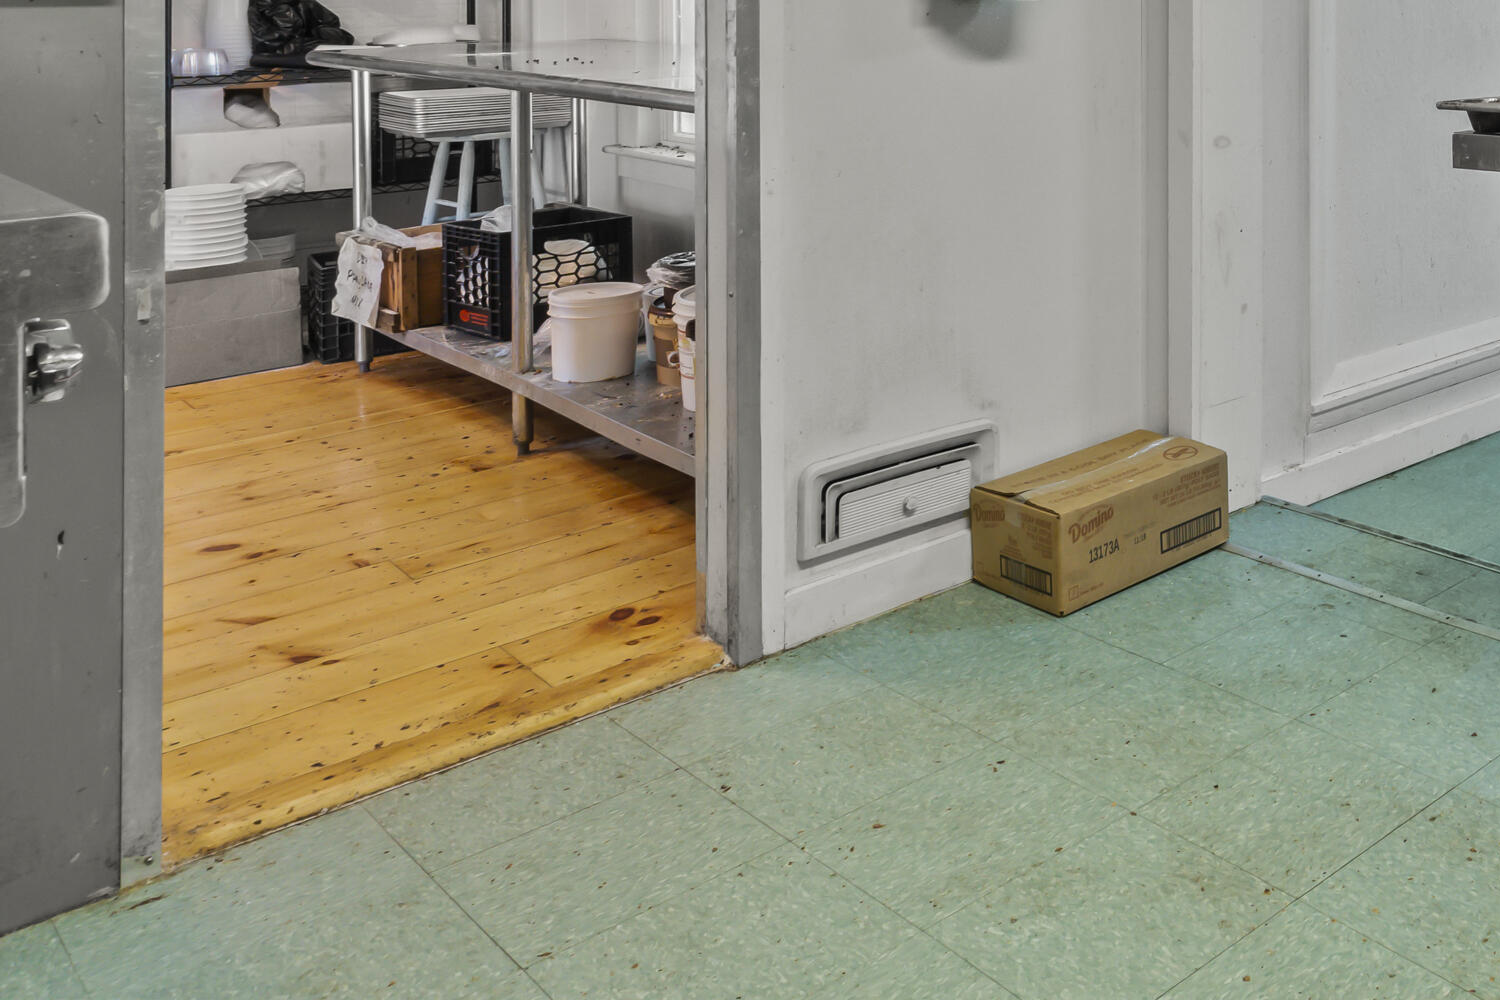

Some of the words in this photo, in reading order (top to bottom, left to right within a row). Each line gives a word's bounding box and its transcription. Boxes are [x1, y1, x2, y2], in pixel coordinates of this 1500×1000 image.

[973, 502, 1006, 523] Domino
[1068, 505, 1115, 545] Domino
[1088, 538, 1120, 564] 13173A
